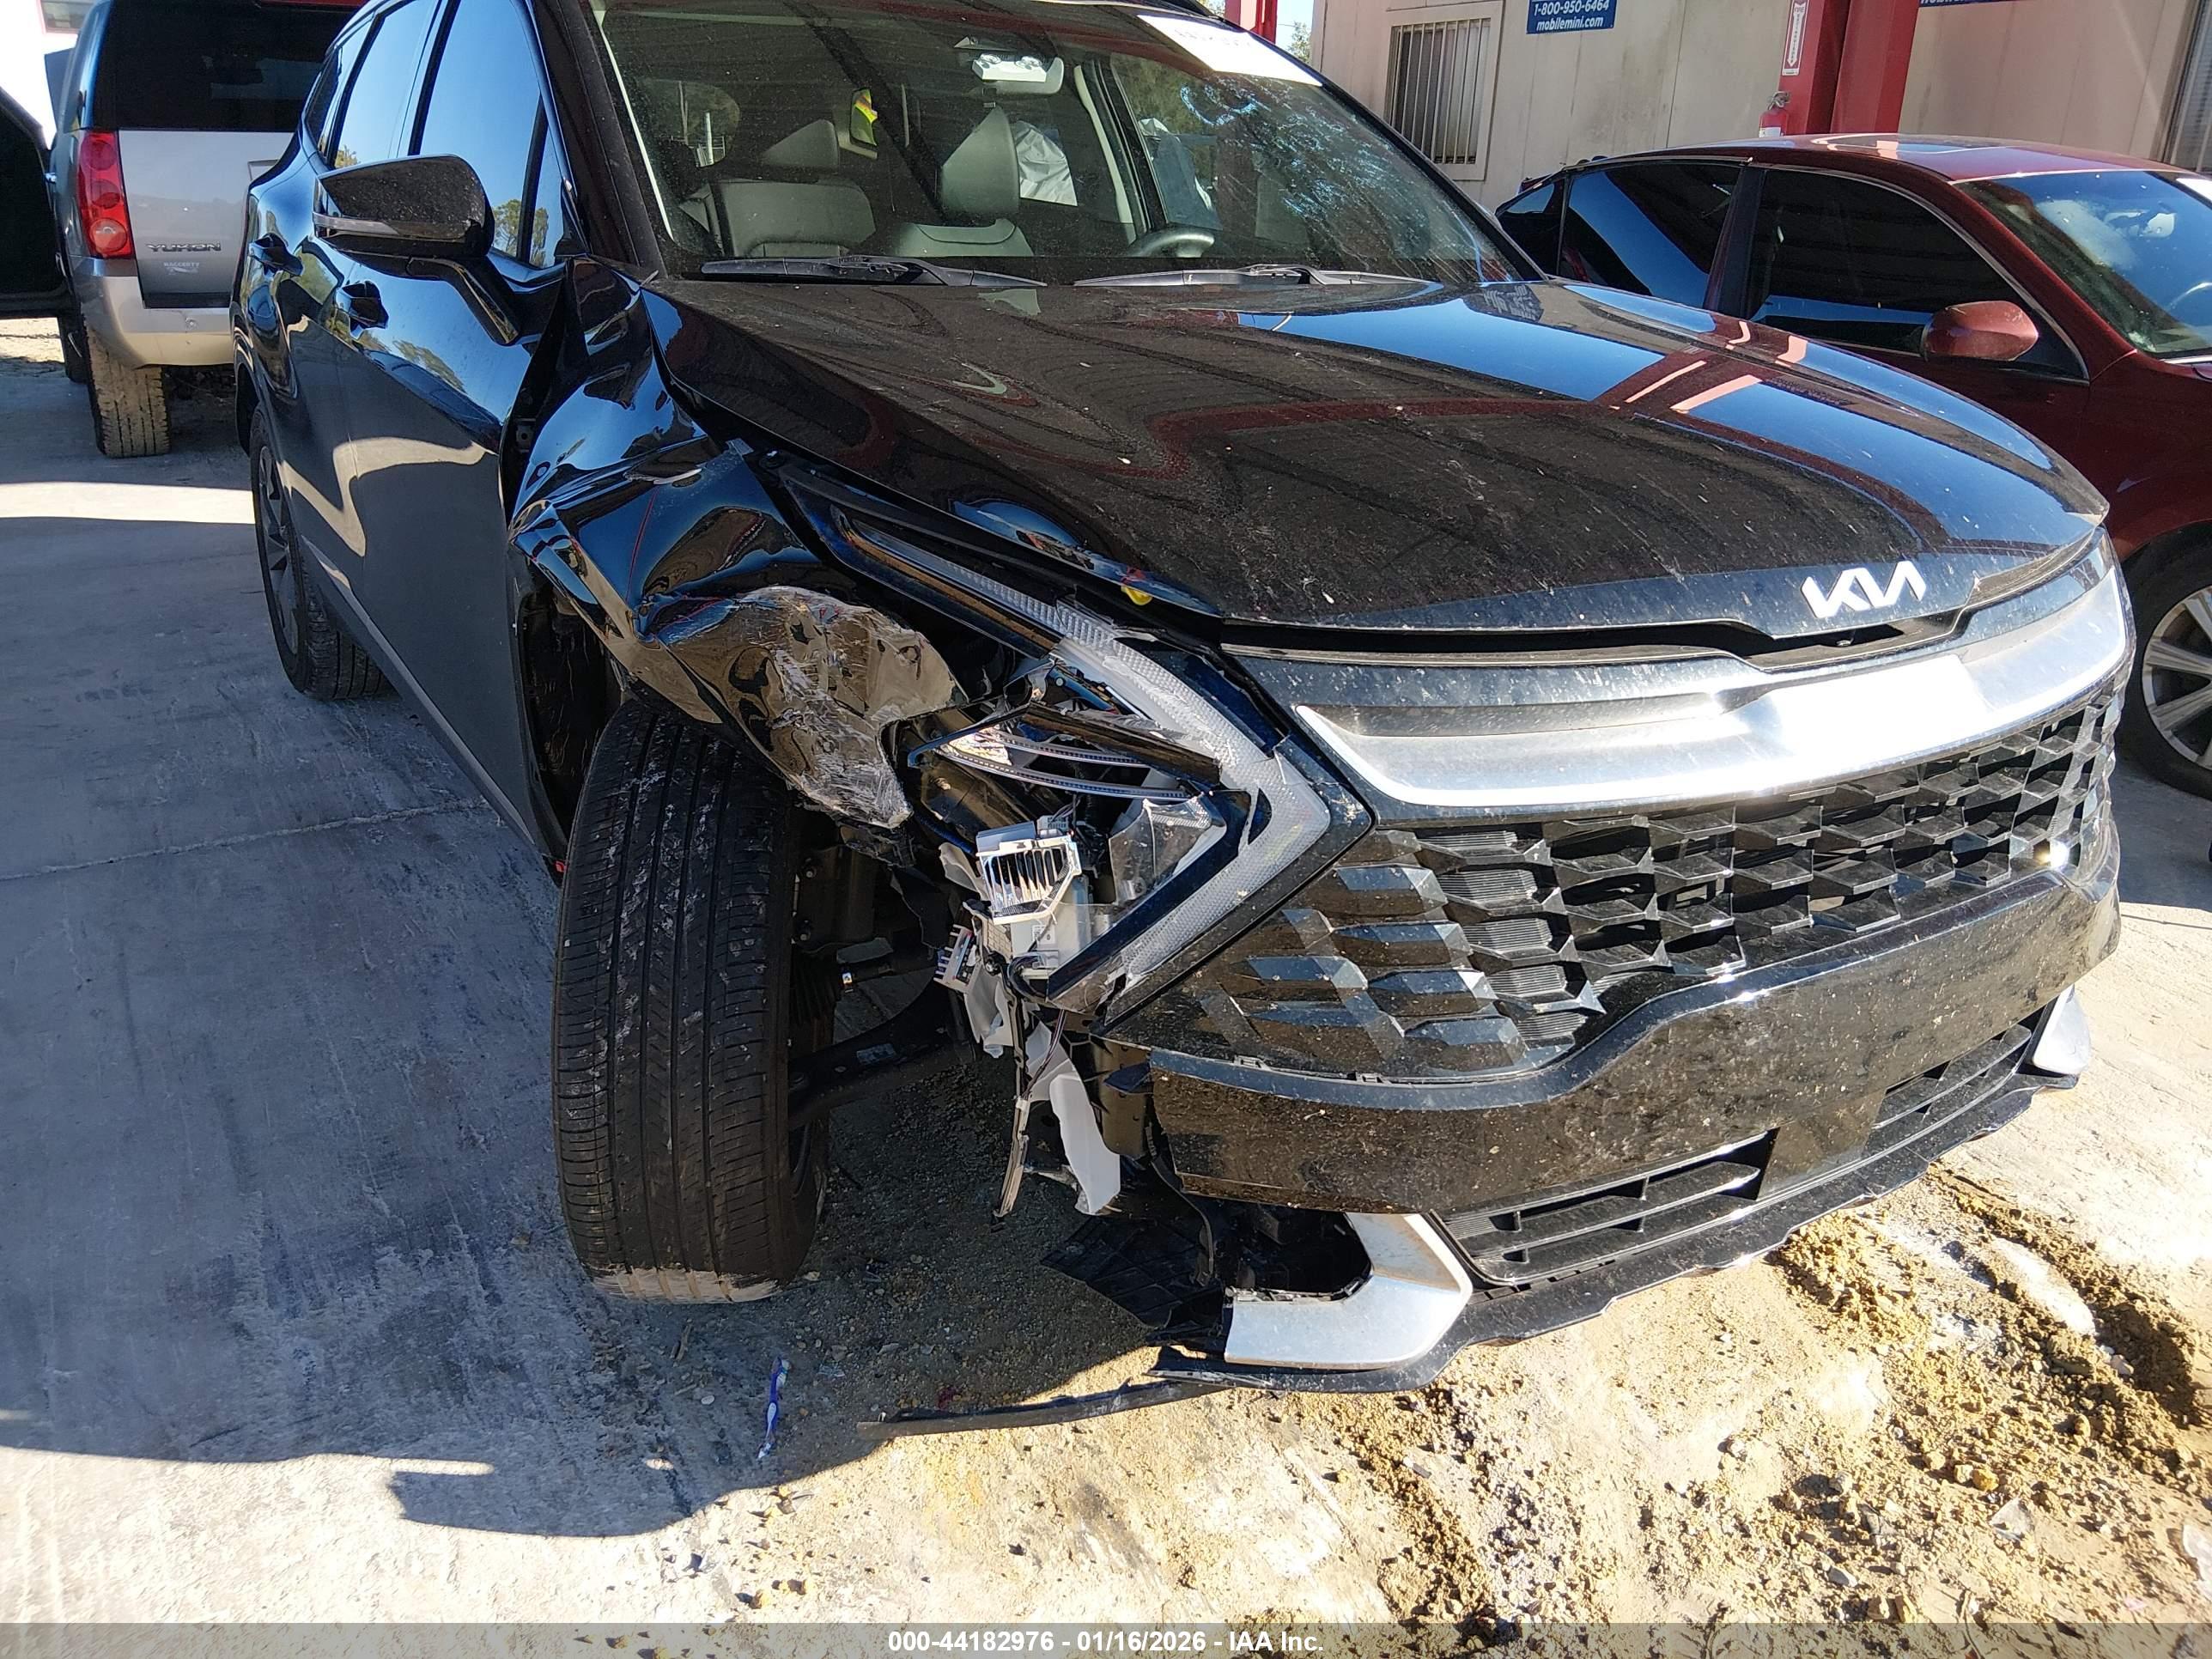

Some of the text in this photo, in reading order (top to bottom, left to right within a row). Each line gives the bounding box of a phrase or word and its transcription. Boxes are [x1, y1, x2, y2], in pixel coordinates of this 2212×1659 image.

[1534, 0, 1609, 16] 1-800-950-6464
[1535, 15, 1604, 31] mobilemini.com
[145, 243, 222, 252] YUKON
[1800, 560, 1927, 619] KIA
